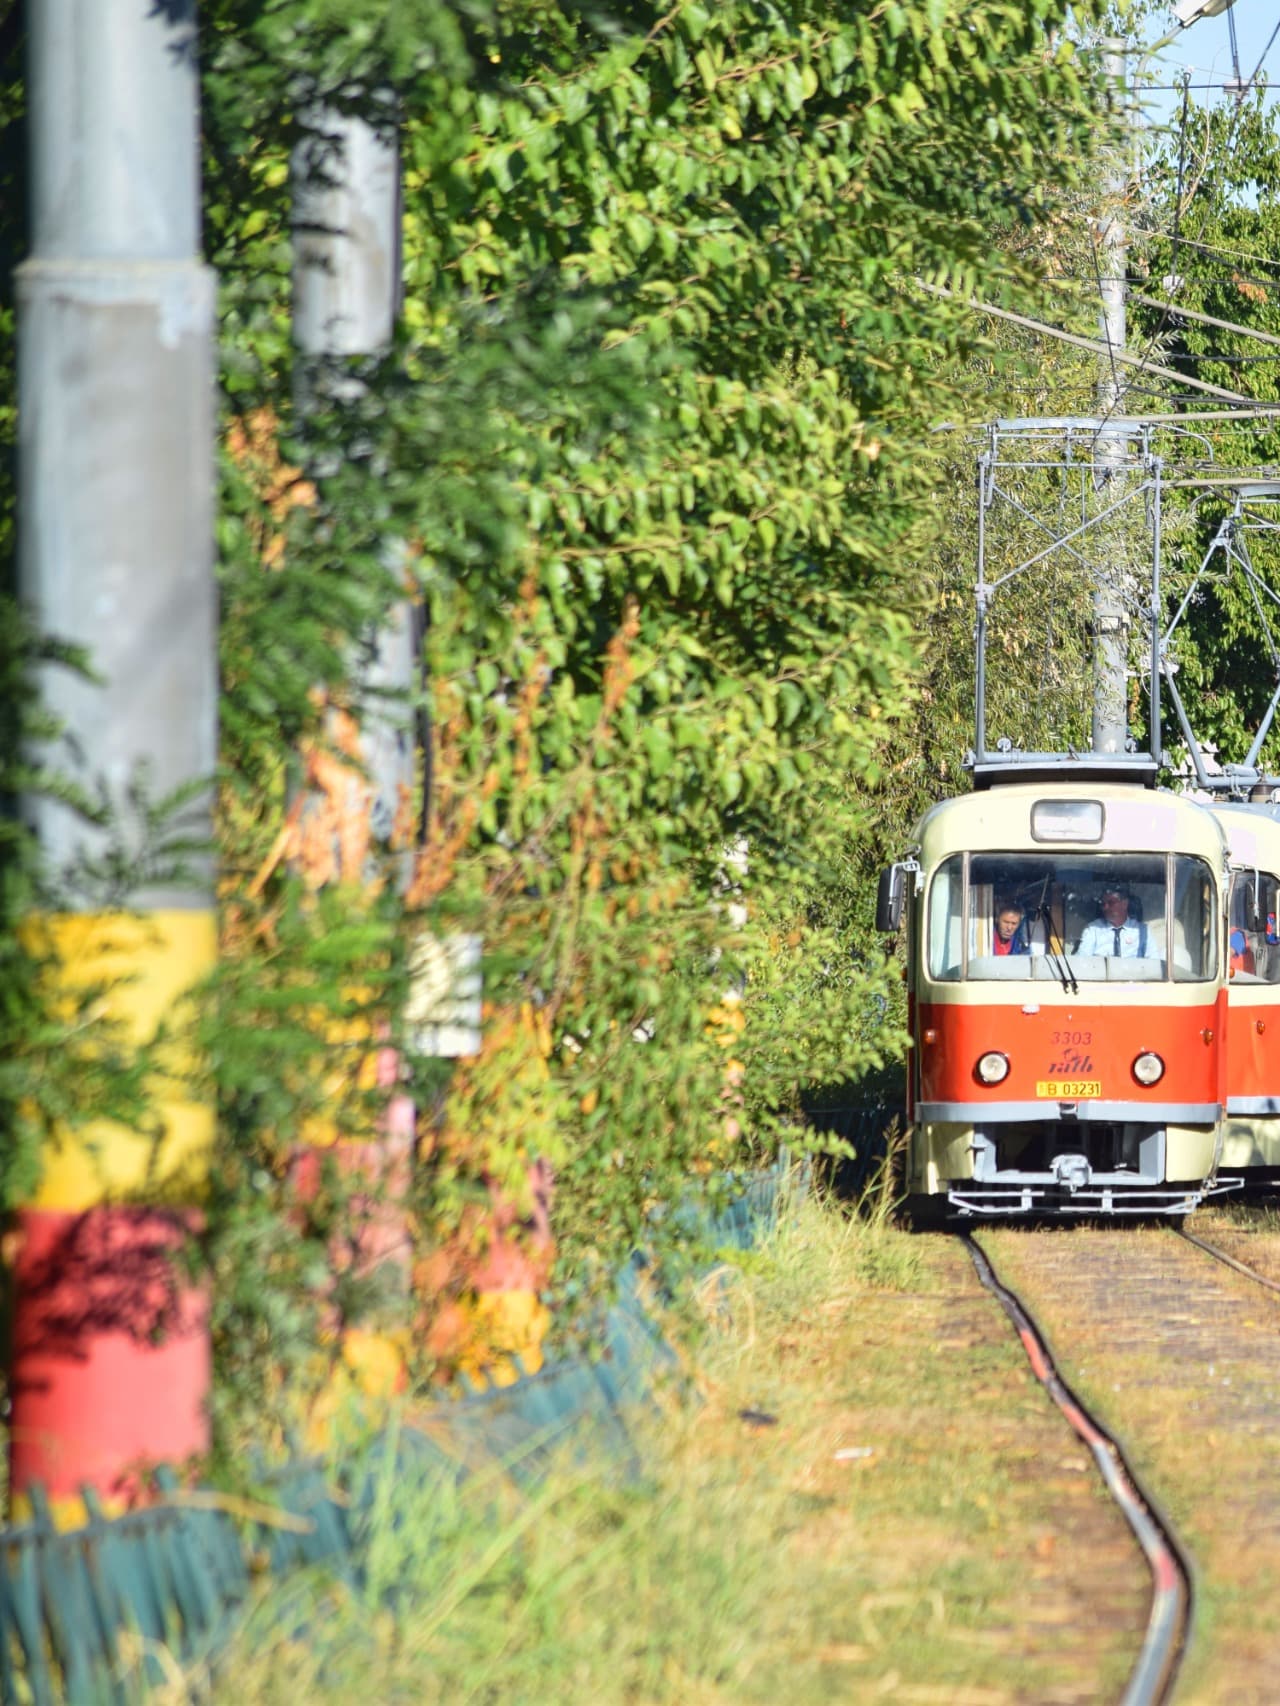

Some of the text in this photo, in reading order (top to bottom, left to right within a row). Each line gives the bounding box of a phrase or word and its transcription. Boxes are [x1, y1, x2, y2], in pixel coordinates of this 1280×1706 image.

[1050, 1031, 1092, 1045] 3303
[1047, 1083, 1100, 1096] B 03231
